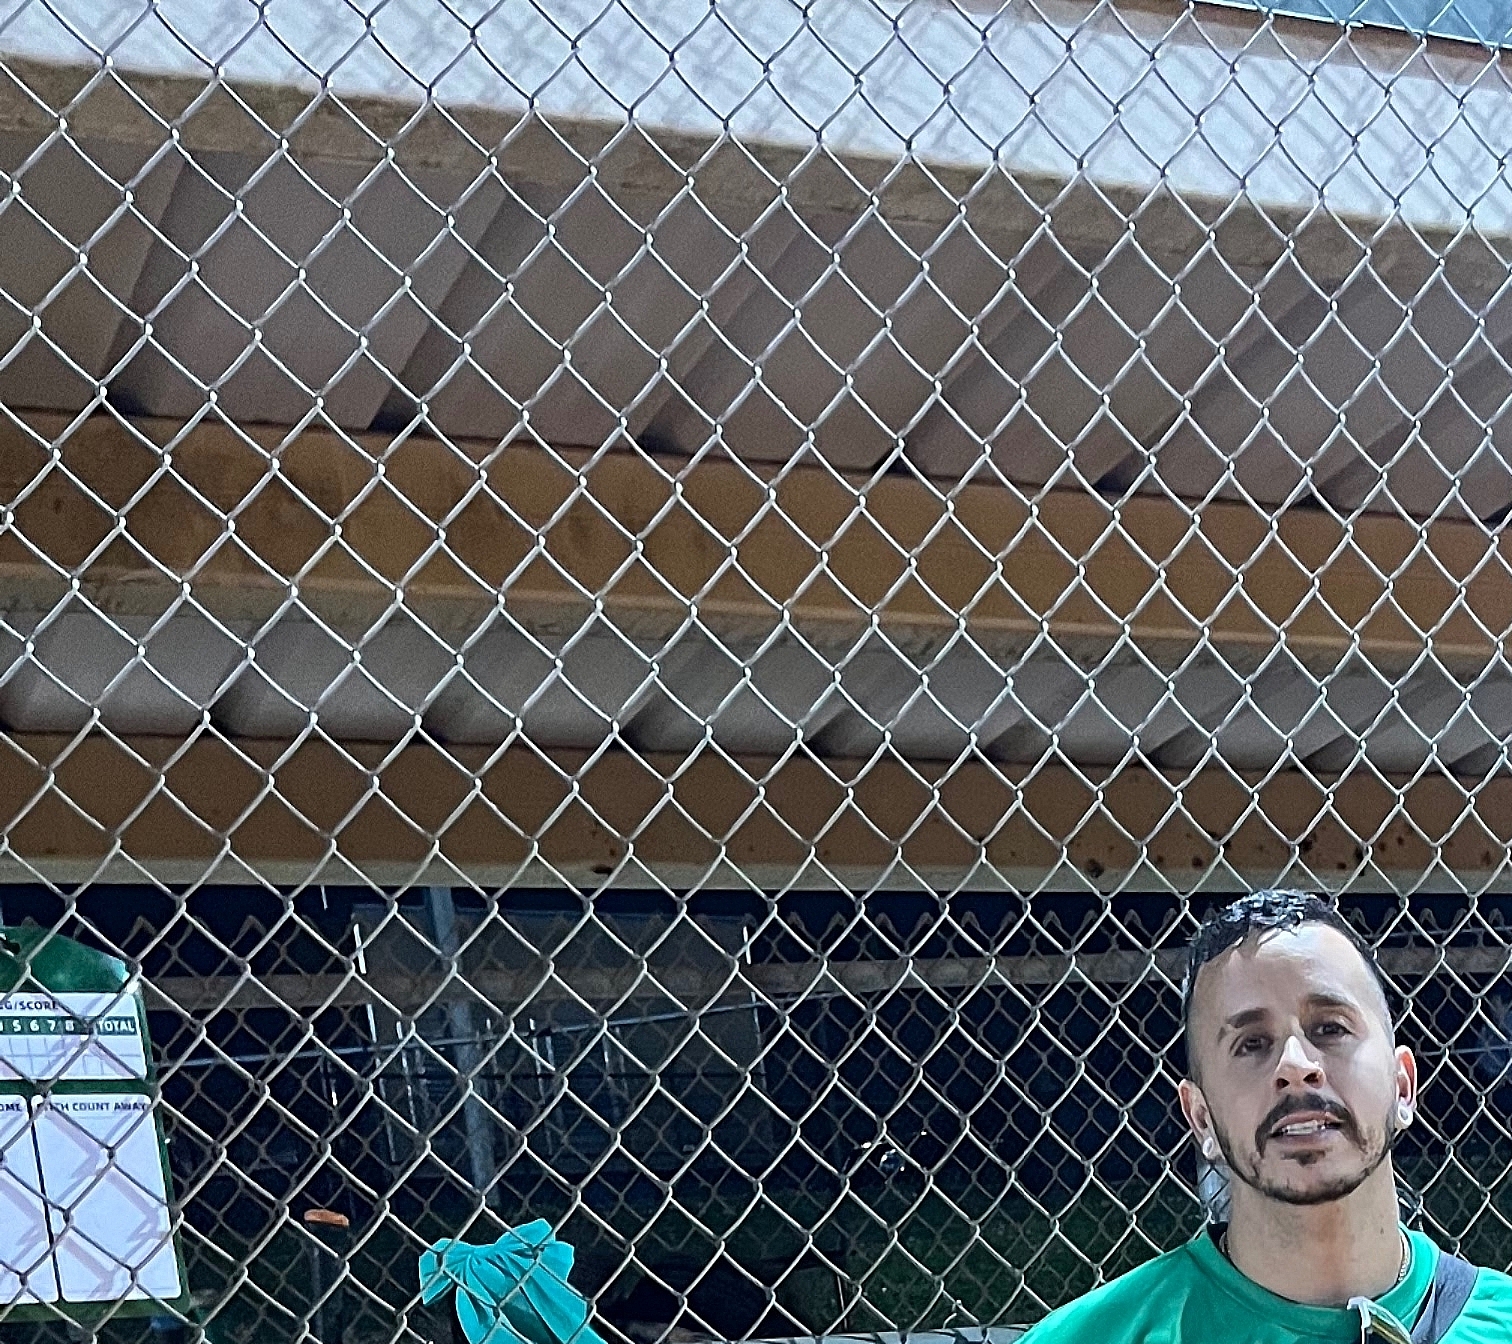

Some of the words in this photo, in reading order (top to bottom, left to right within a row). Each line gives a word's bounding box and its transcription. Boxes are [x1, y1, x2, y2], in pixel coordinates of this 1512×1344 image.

[12, 1019, 22, 1032] 5
[29, 1019, 40, 1032] 6
[46, 1019, 56, 1032] 7
[98, 1019, 136, 1033] TOTAL
[72, 1102, 111, 1111] COUNT
[113, 1102, 146, 1111] AWAY
